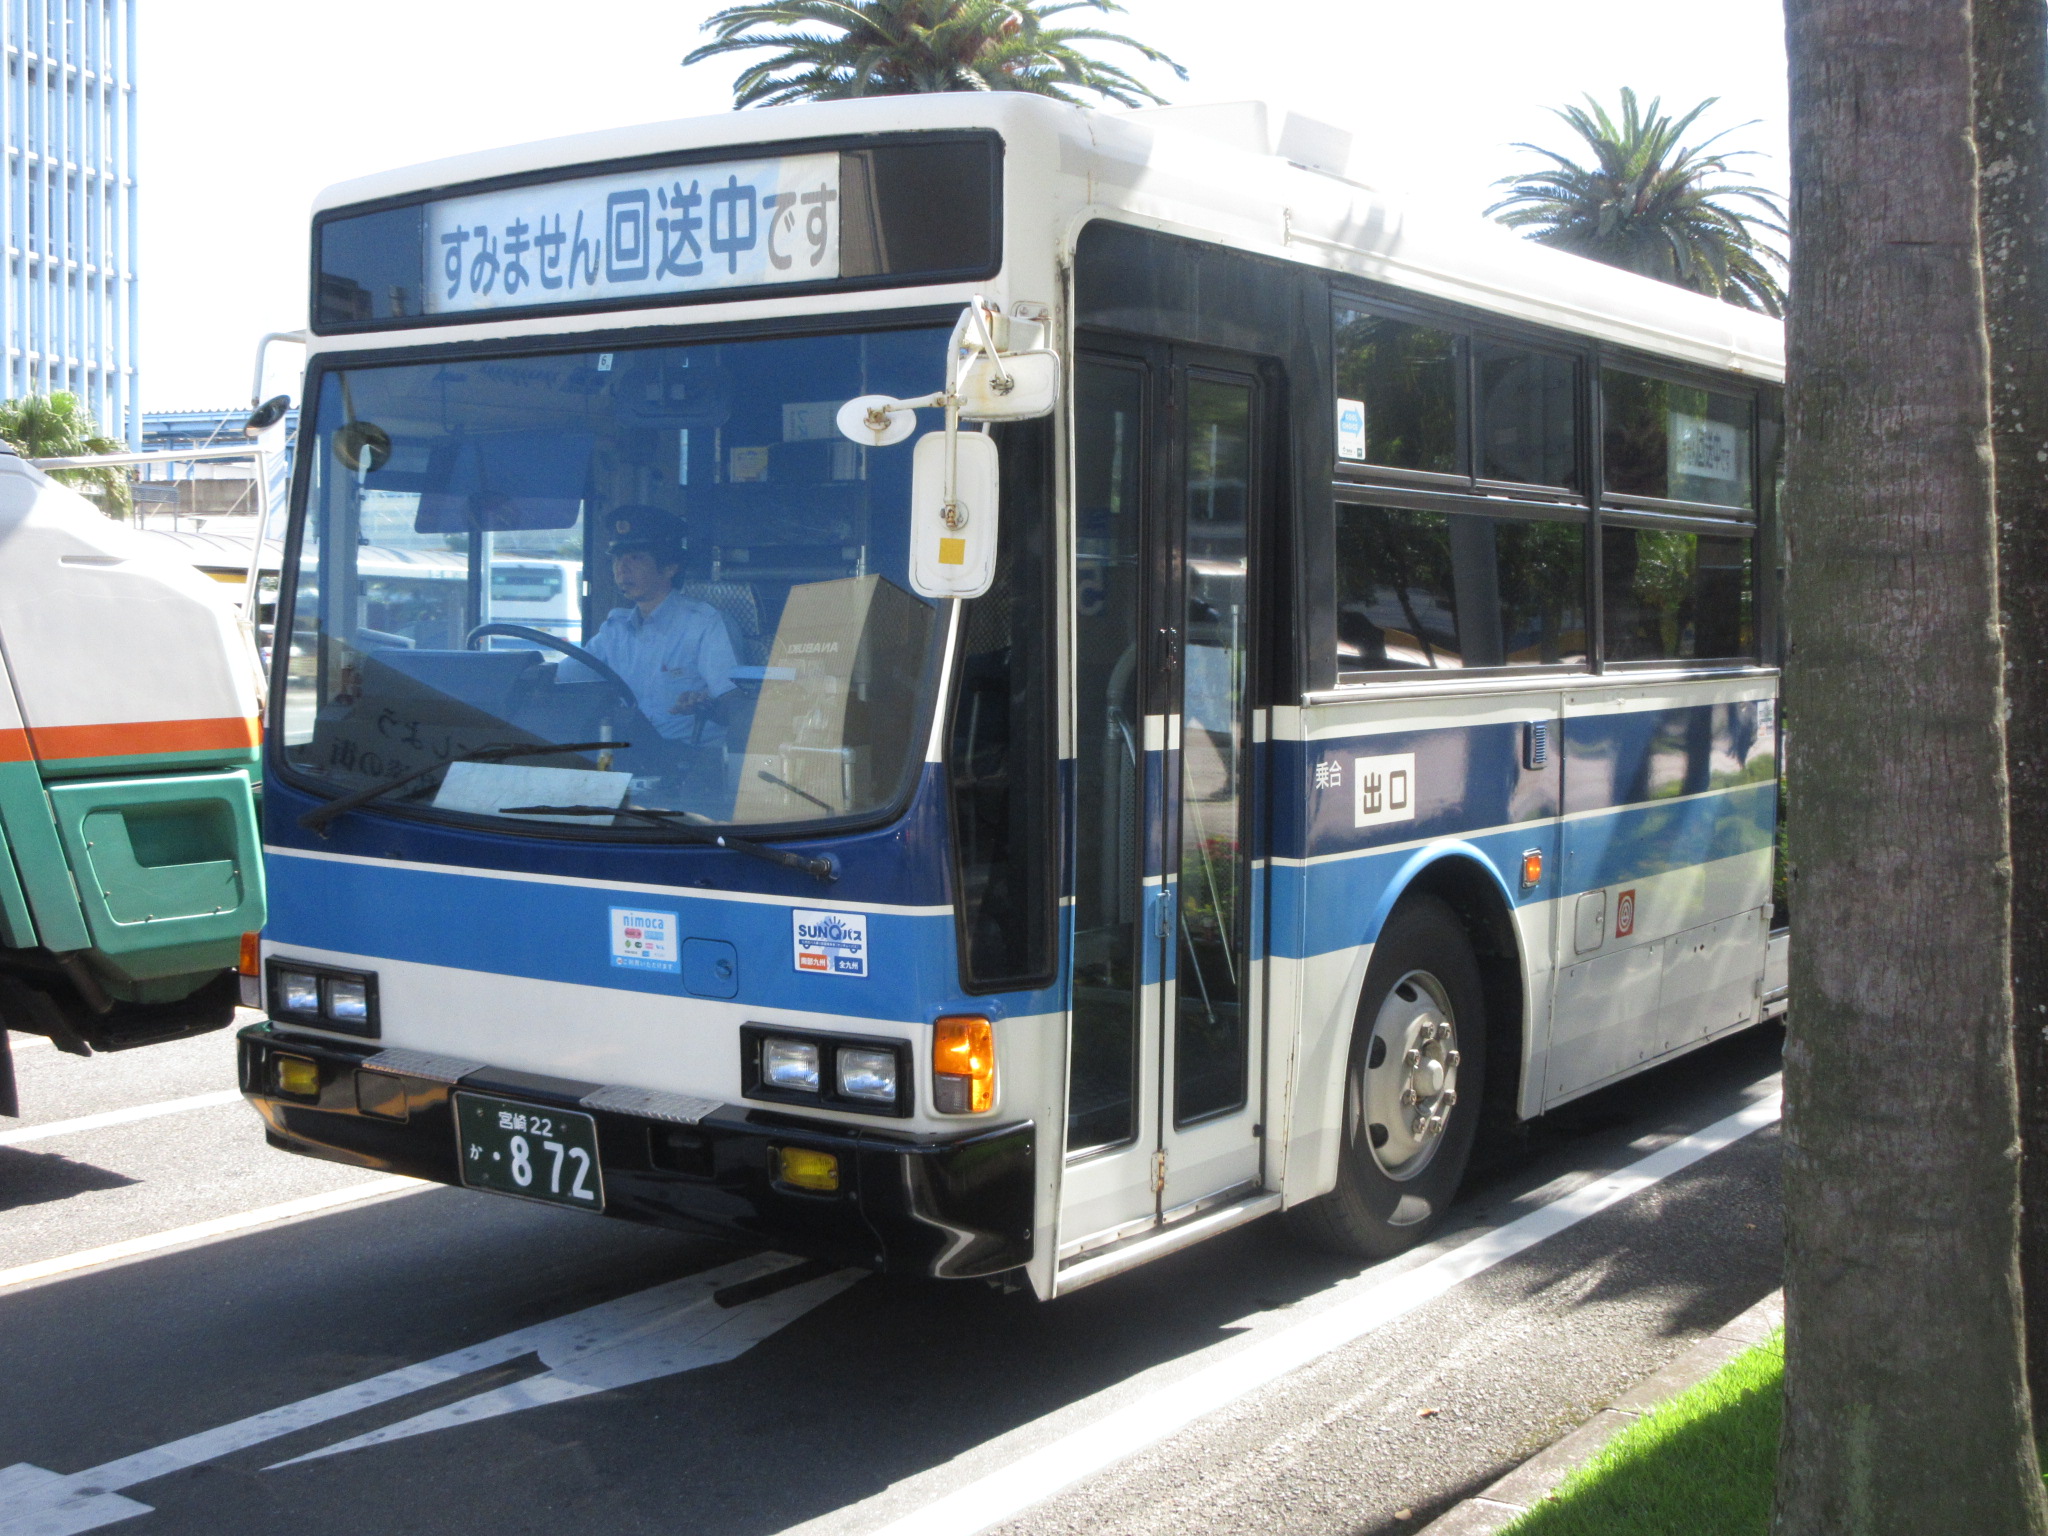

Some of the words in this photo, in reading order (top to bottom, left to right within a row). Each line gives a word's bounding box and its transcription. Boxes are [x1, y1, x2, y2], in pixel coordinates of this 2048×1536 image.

[440, 175, 838, 300] すみません回送中です
[1316, 760, 1342, 789] 乗合
[1363, 769, 1407, 814] 出口
[623, 912, 664, 929] nimoca
[838, 960, 859, 971] 全九州
[498, 1111, 527, 1132] 宮崎
[530, 1116, 553, 1137] 22
